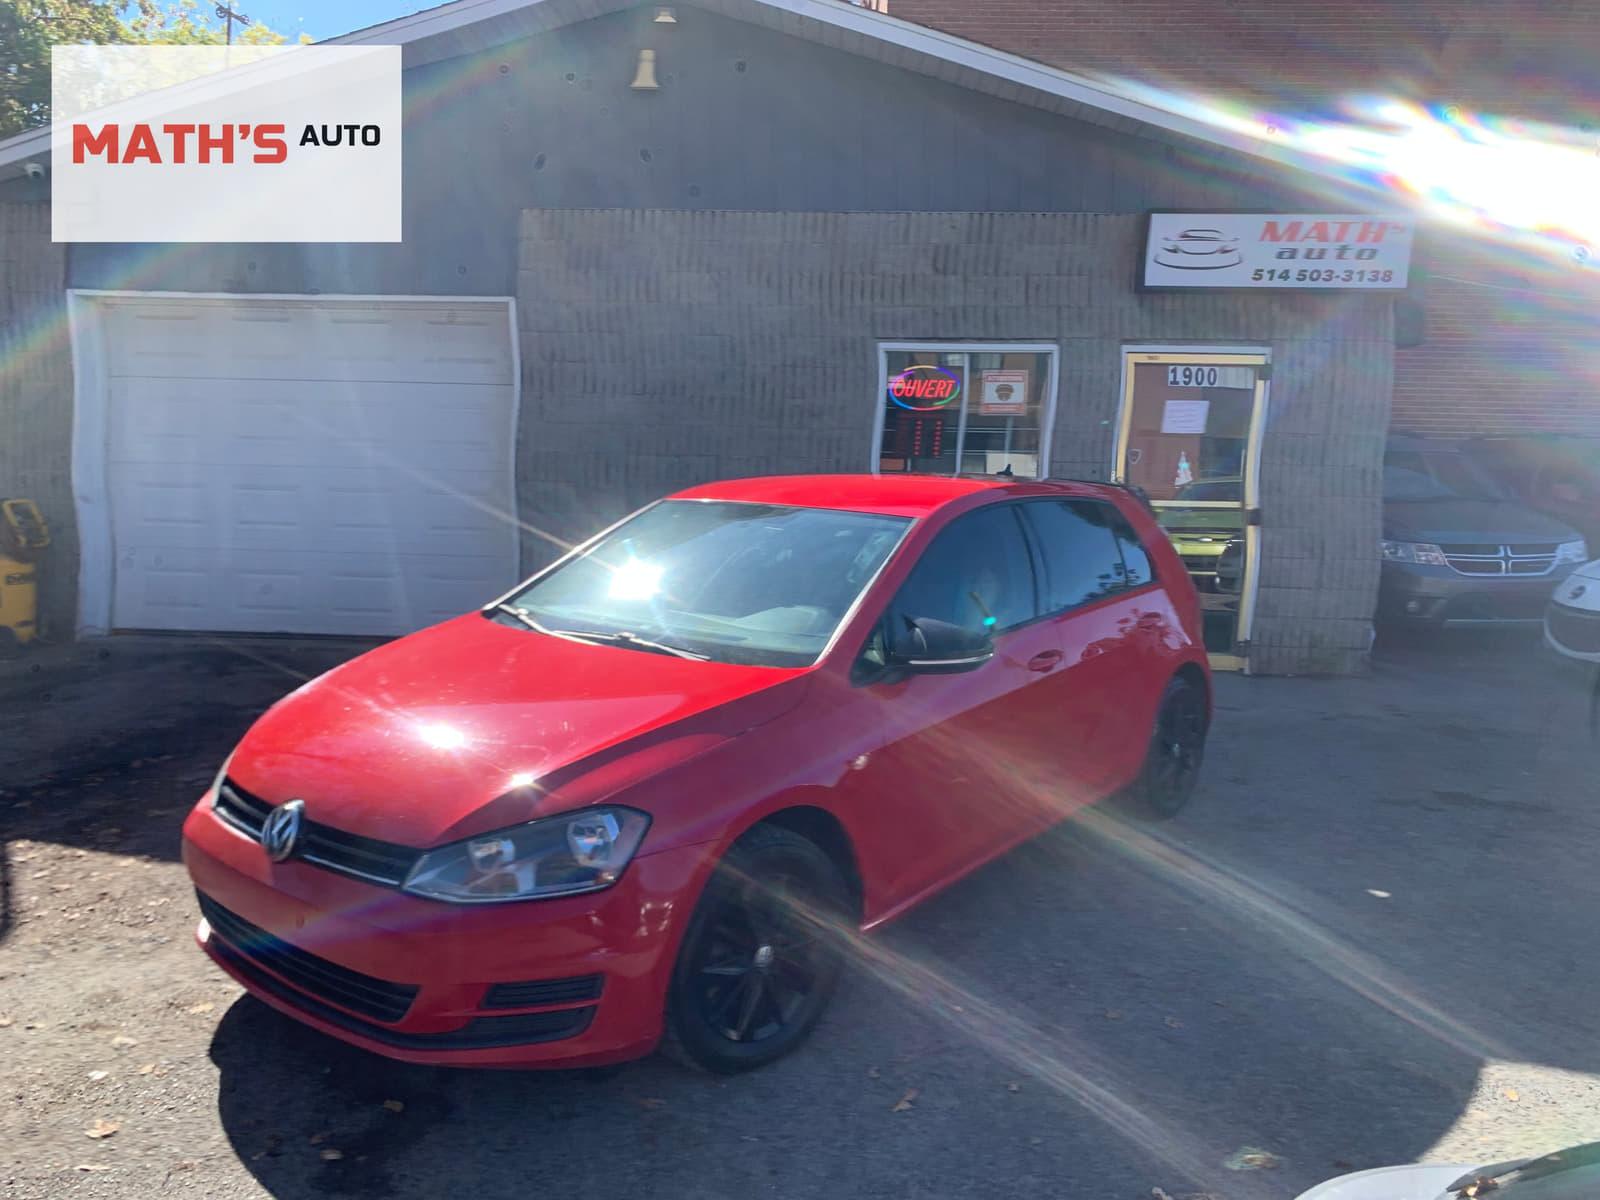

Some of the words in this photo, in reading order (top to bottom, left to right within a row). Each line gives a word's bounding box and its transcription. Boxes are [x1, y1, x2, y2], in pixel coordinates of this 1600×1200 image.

[1275, 245, 1377, 260] auto
[1251, 268, 1290, 281] 514
[1296, 269, 1393, 282] 503-3138
[1169, 366, 1217, 386] 1900
[893, 379, 956, 398] OUVERT
